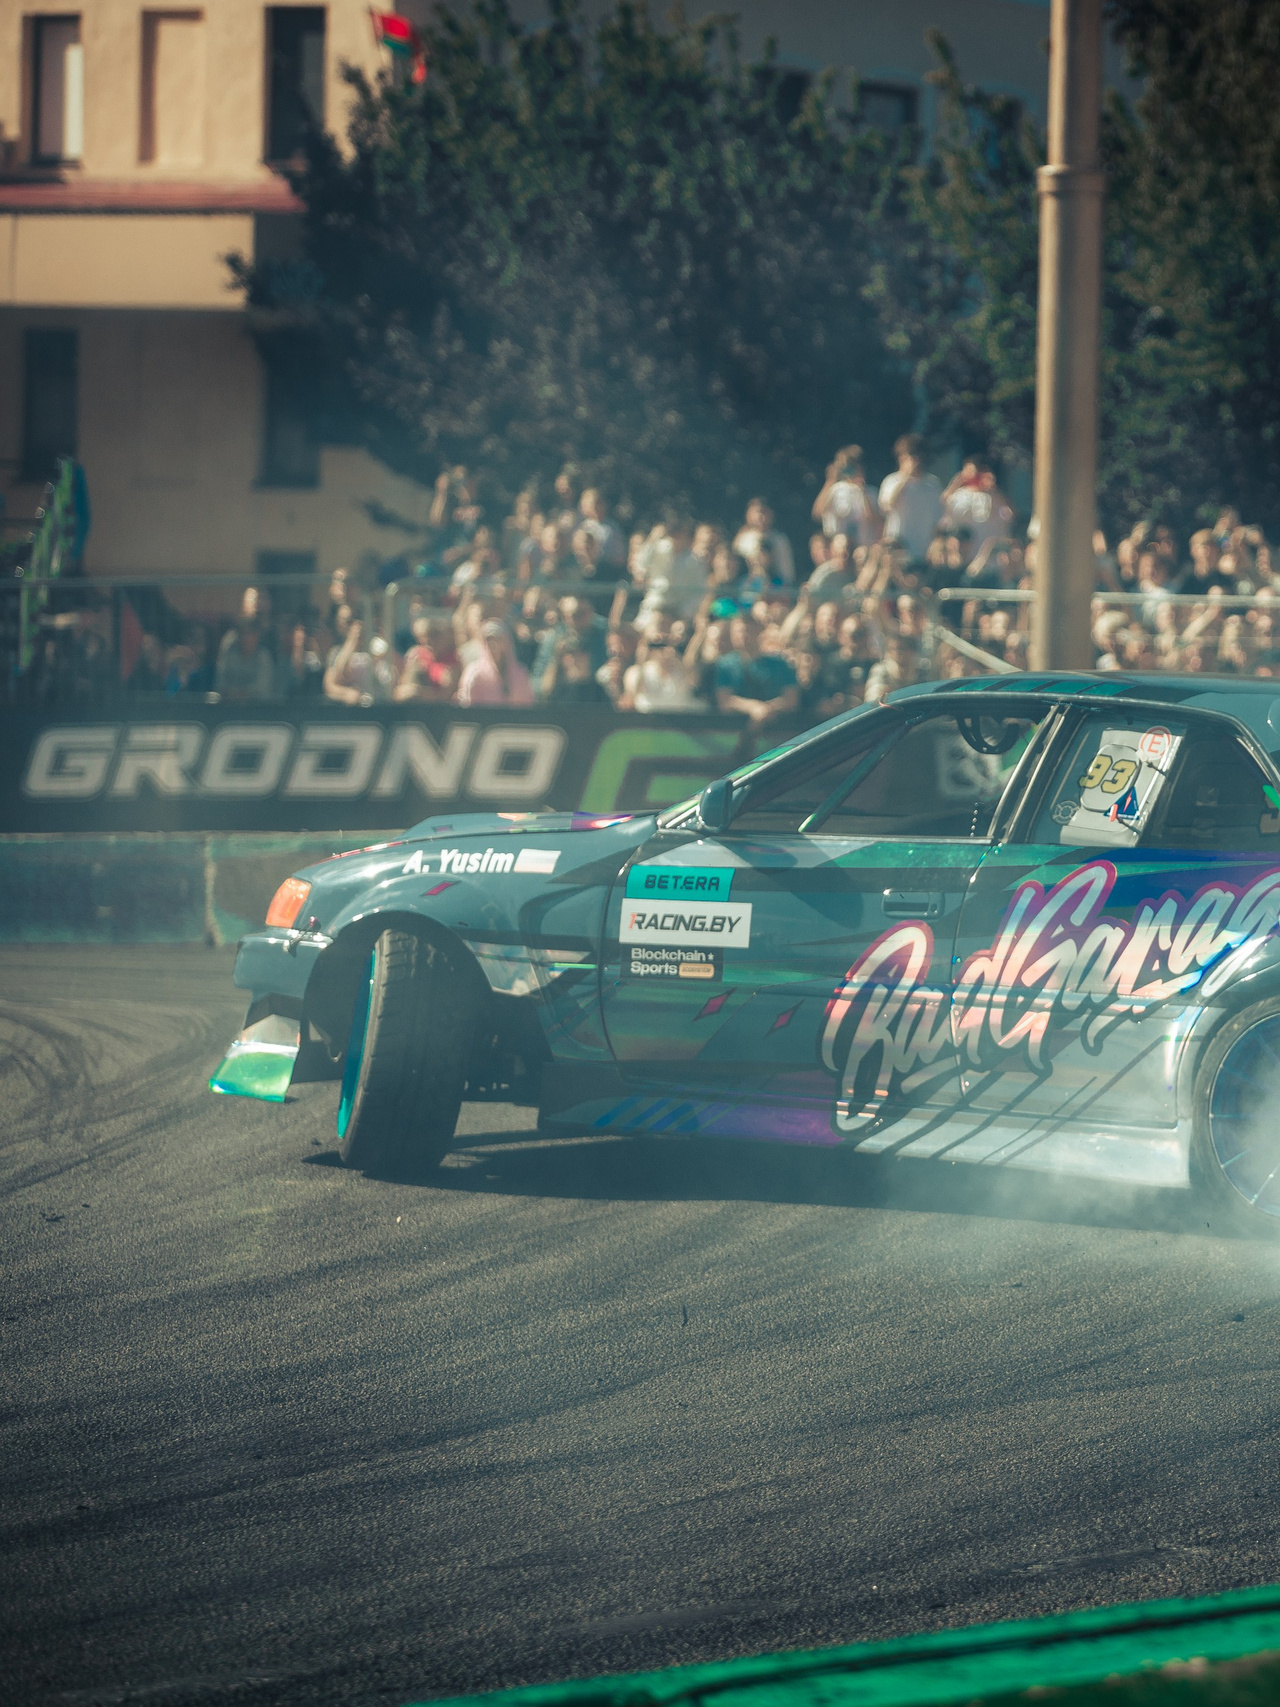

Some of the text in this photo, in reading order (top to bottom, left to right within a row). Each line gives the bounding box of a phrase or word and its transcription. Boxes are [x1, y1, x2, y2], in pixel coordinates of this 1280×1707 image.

[23, 723, 567, 798] GRODNO
[1079, 754, 1138, 794] 93
[402, 847, 515, 875] A. Yusim
[630, 947, 707, 961] Blockchain
[630, 961, 678, 977] Sports
